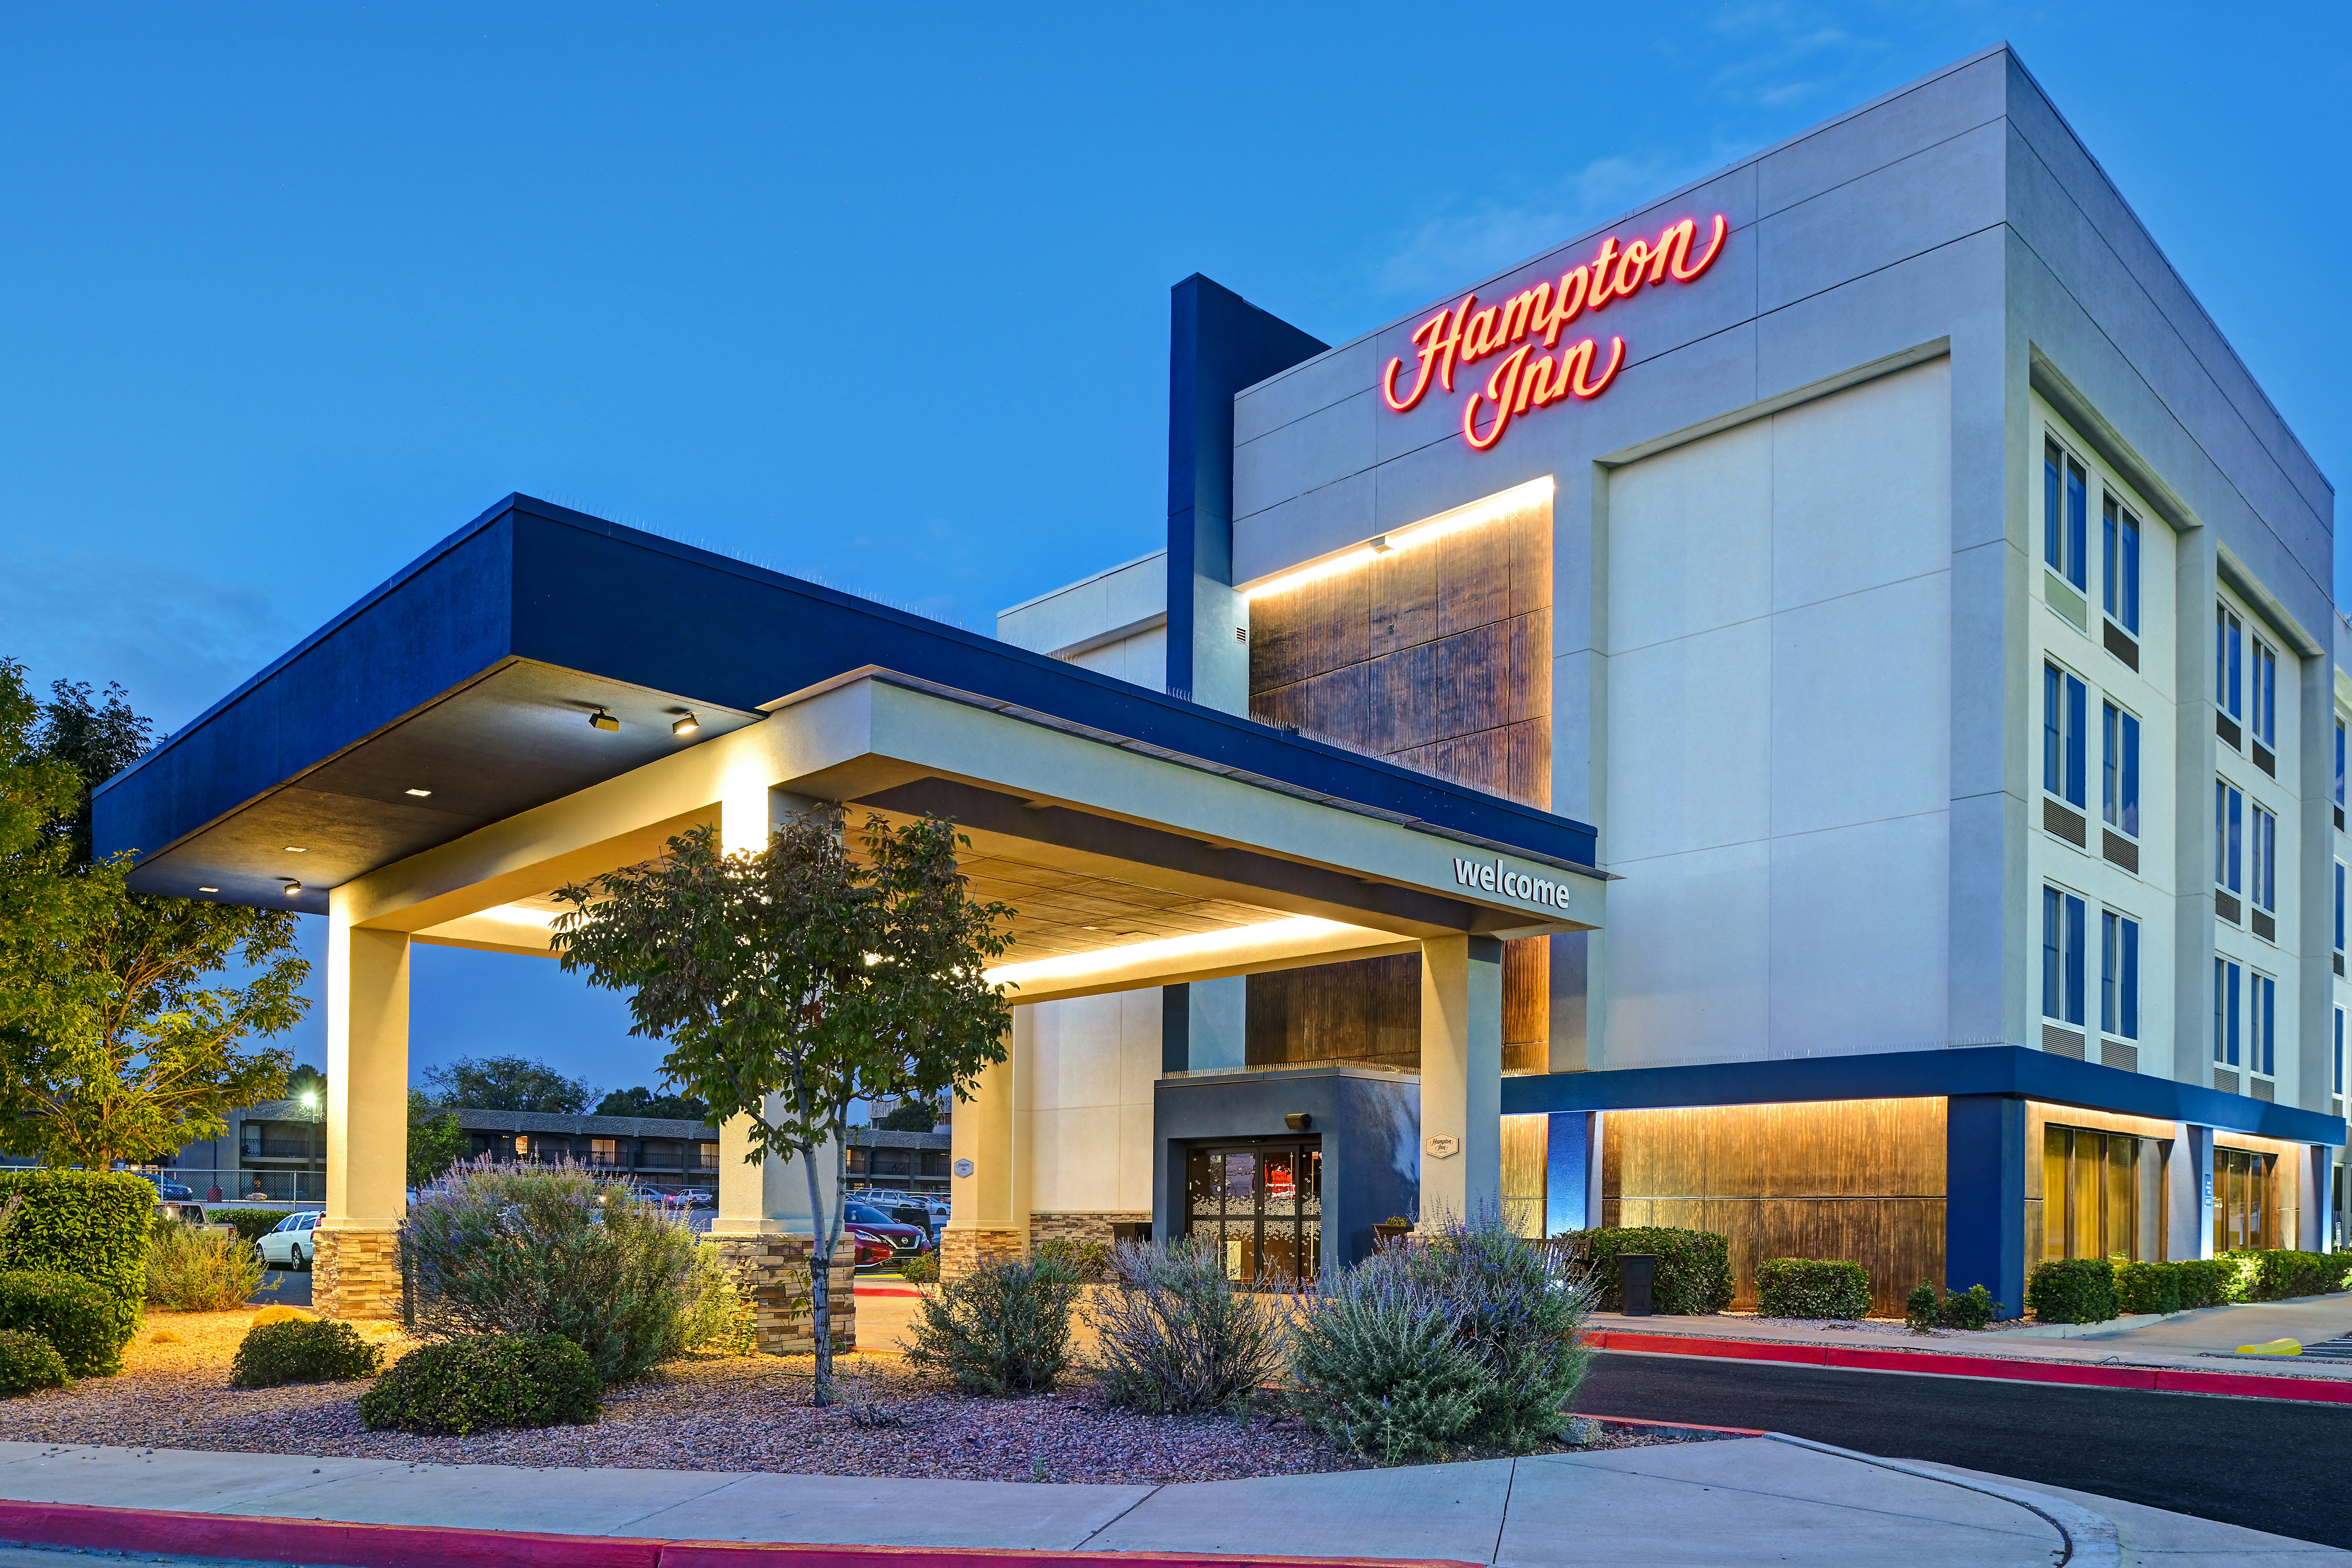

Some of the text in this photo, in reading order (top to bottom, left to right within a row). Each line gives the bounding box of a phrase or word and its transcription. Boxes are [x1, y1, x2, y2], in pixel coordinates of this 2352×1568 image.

[1383, 214, 1728, 412] Hampton
[1465, 336, 1626, 449] Inn
[1453, 858, 1569, 909] welcome
